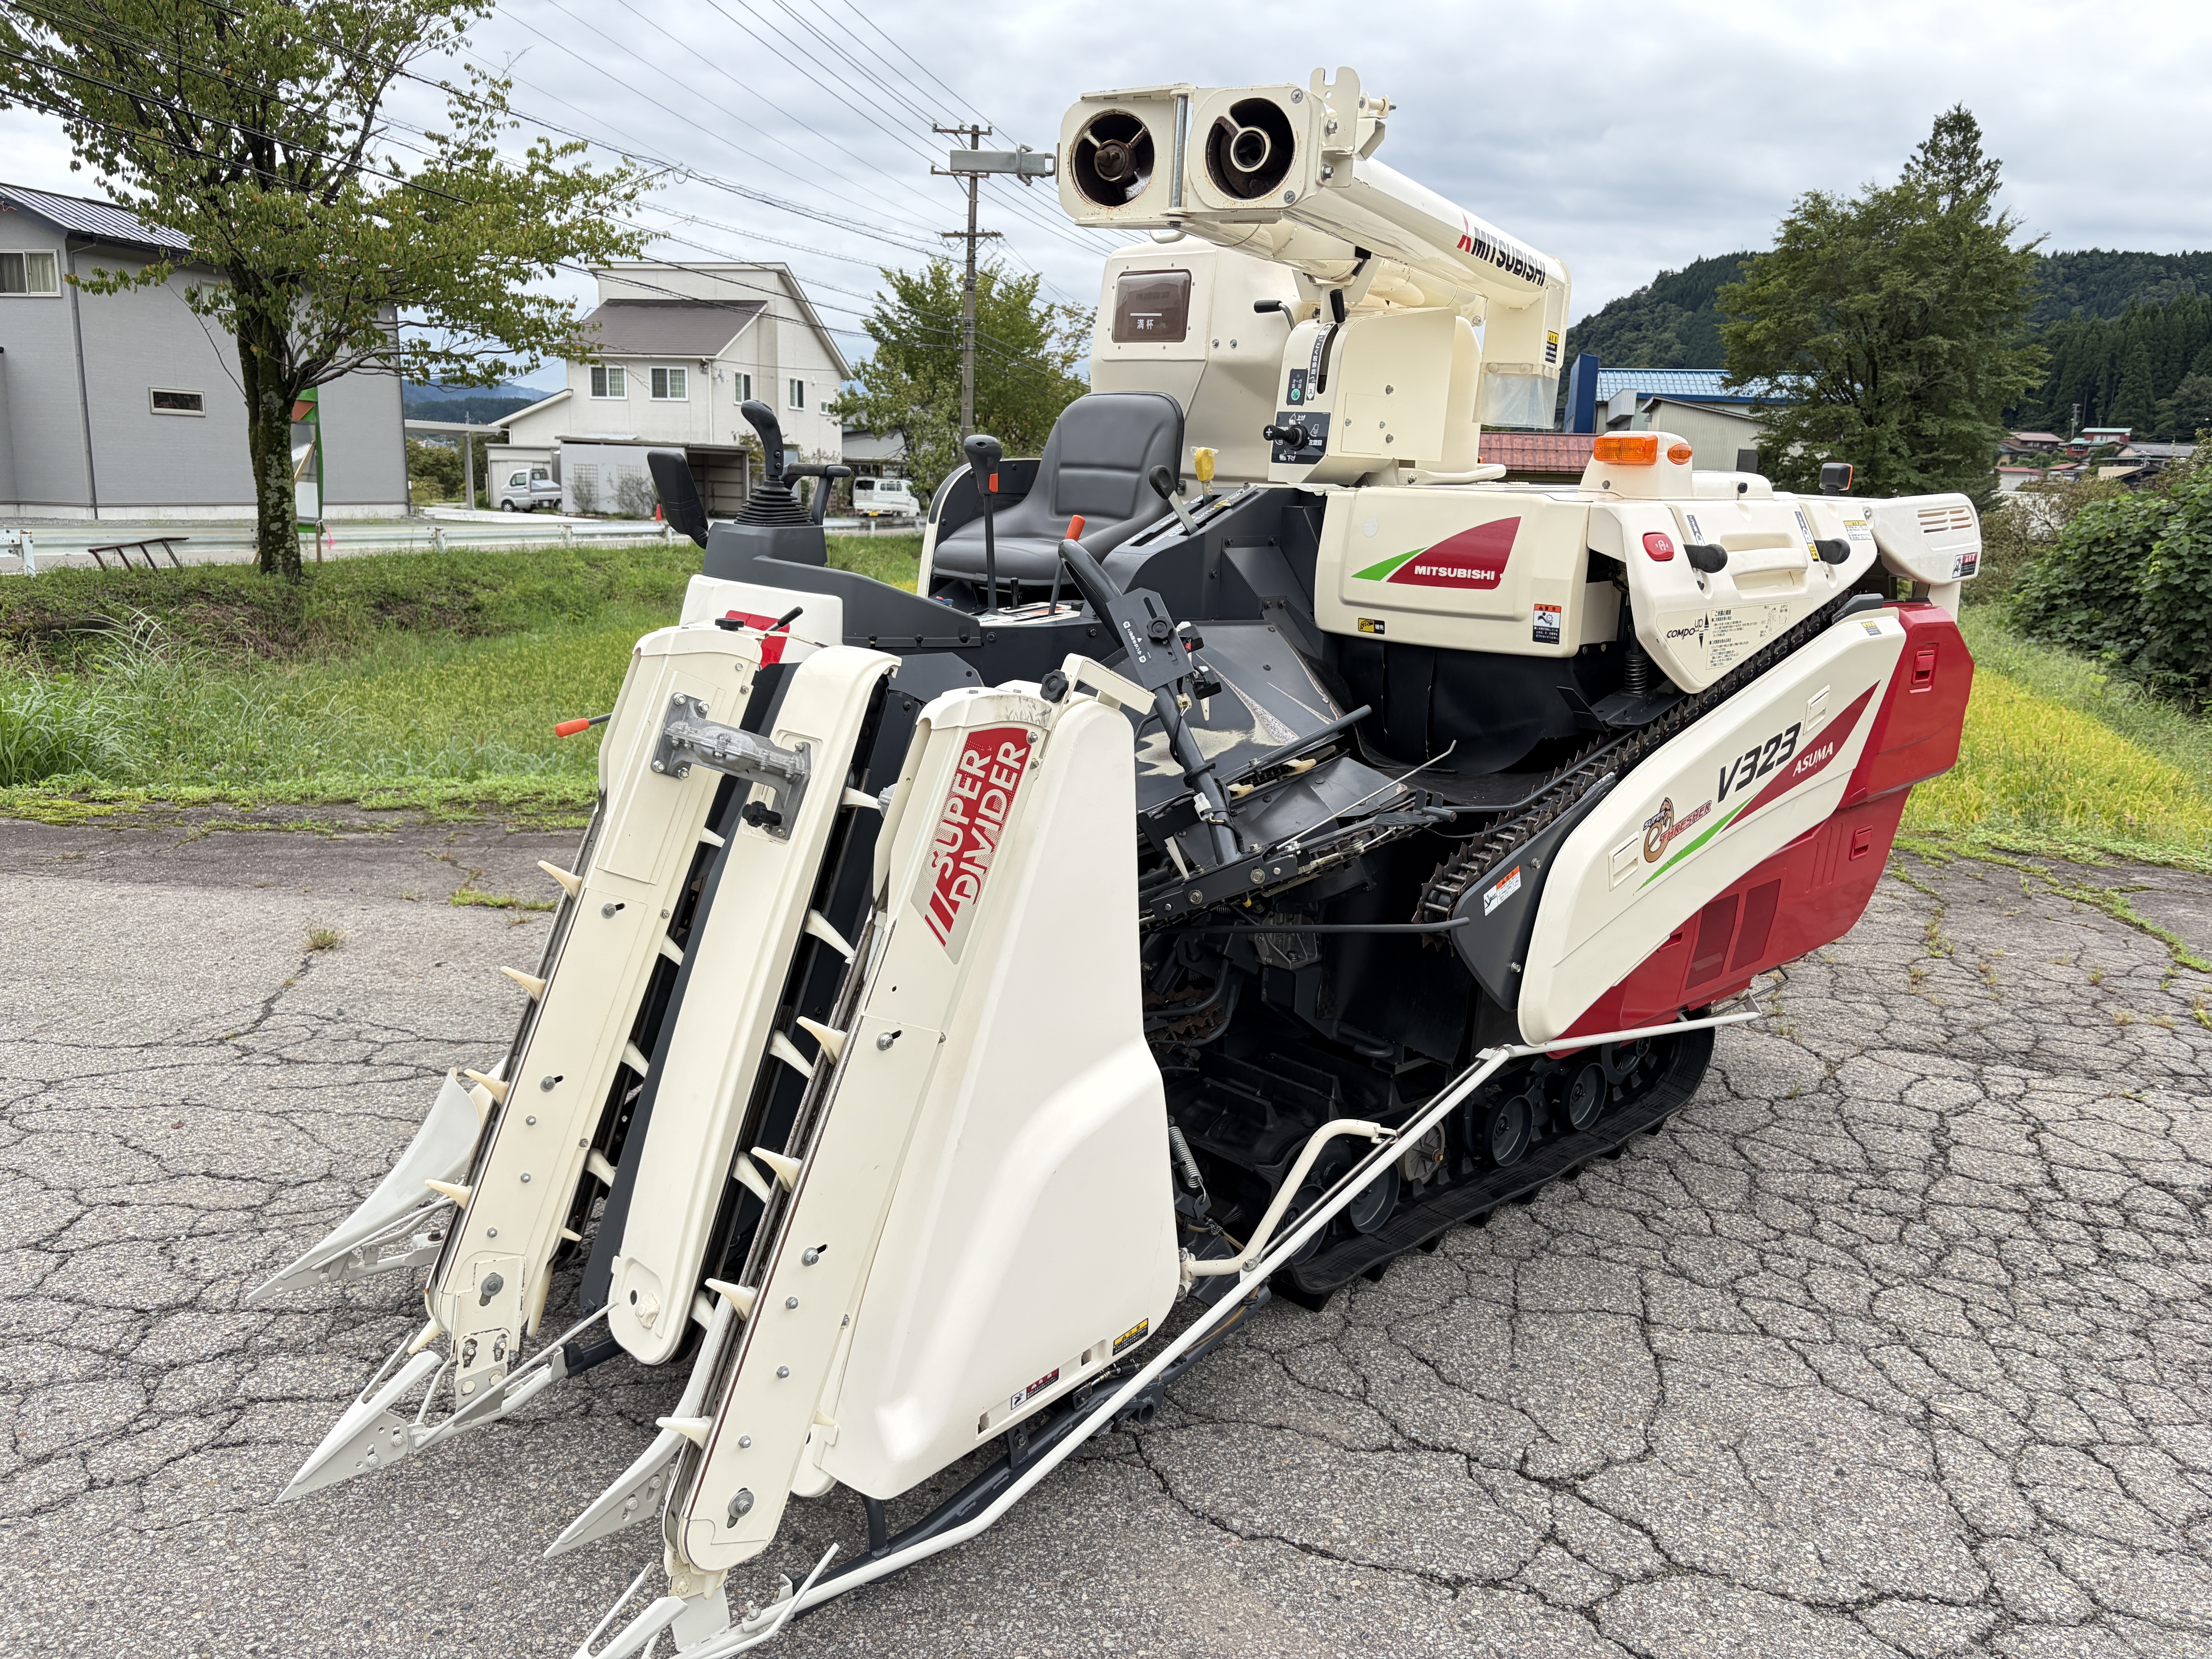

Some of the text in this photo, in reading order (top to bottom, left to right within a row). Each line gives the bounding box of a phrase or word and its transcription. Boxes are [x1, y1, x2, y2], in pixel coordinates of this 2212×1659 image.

[1471, 227, 1546, 287] MITSUBISHI
[1137, 319, 1154, 330] 満杯
[1414, 565, 1495, 580] MITSUBISHI
[1718, 722, 1801, 803] V323
[1793, 741, 1833, 777] ASUMA
[929, 749, 991, 879] SUPER
[948, 741, 1027, 905] DIVIDER
[1644, 810, 1666, 829] SUPER
[1661, 802, 1711, 843] THRESHER
